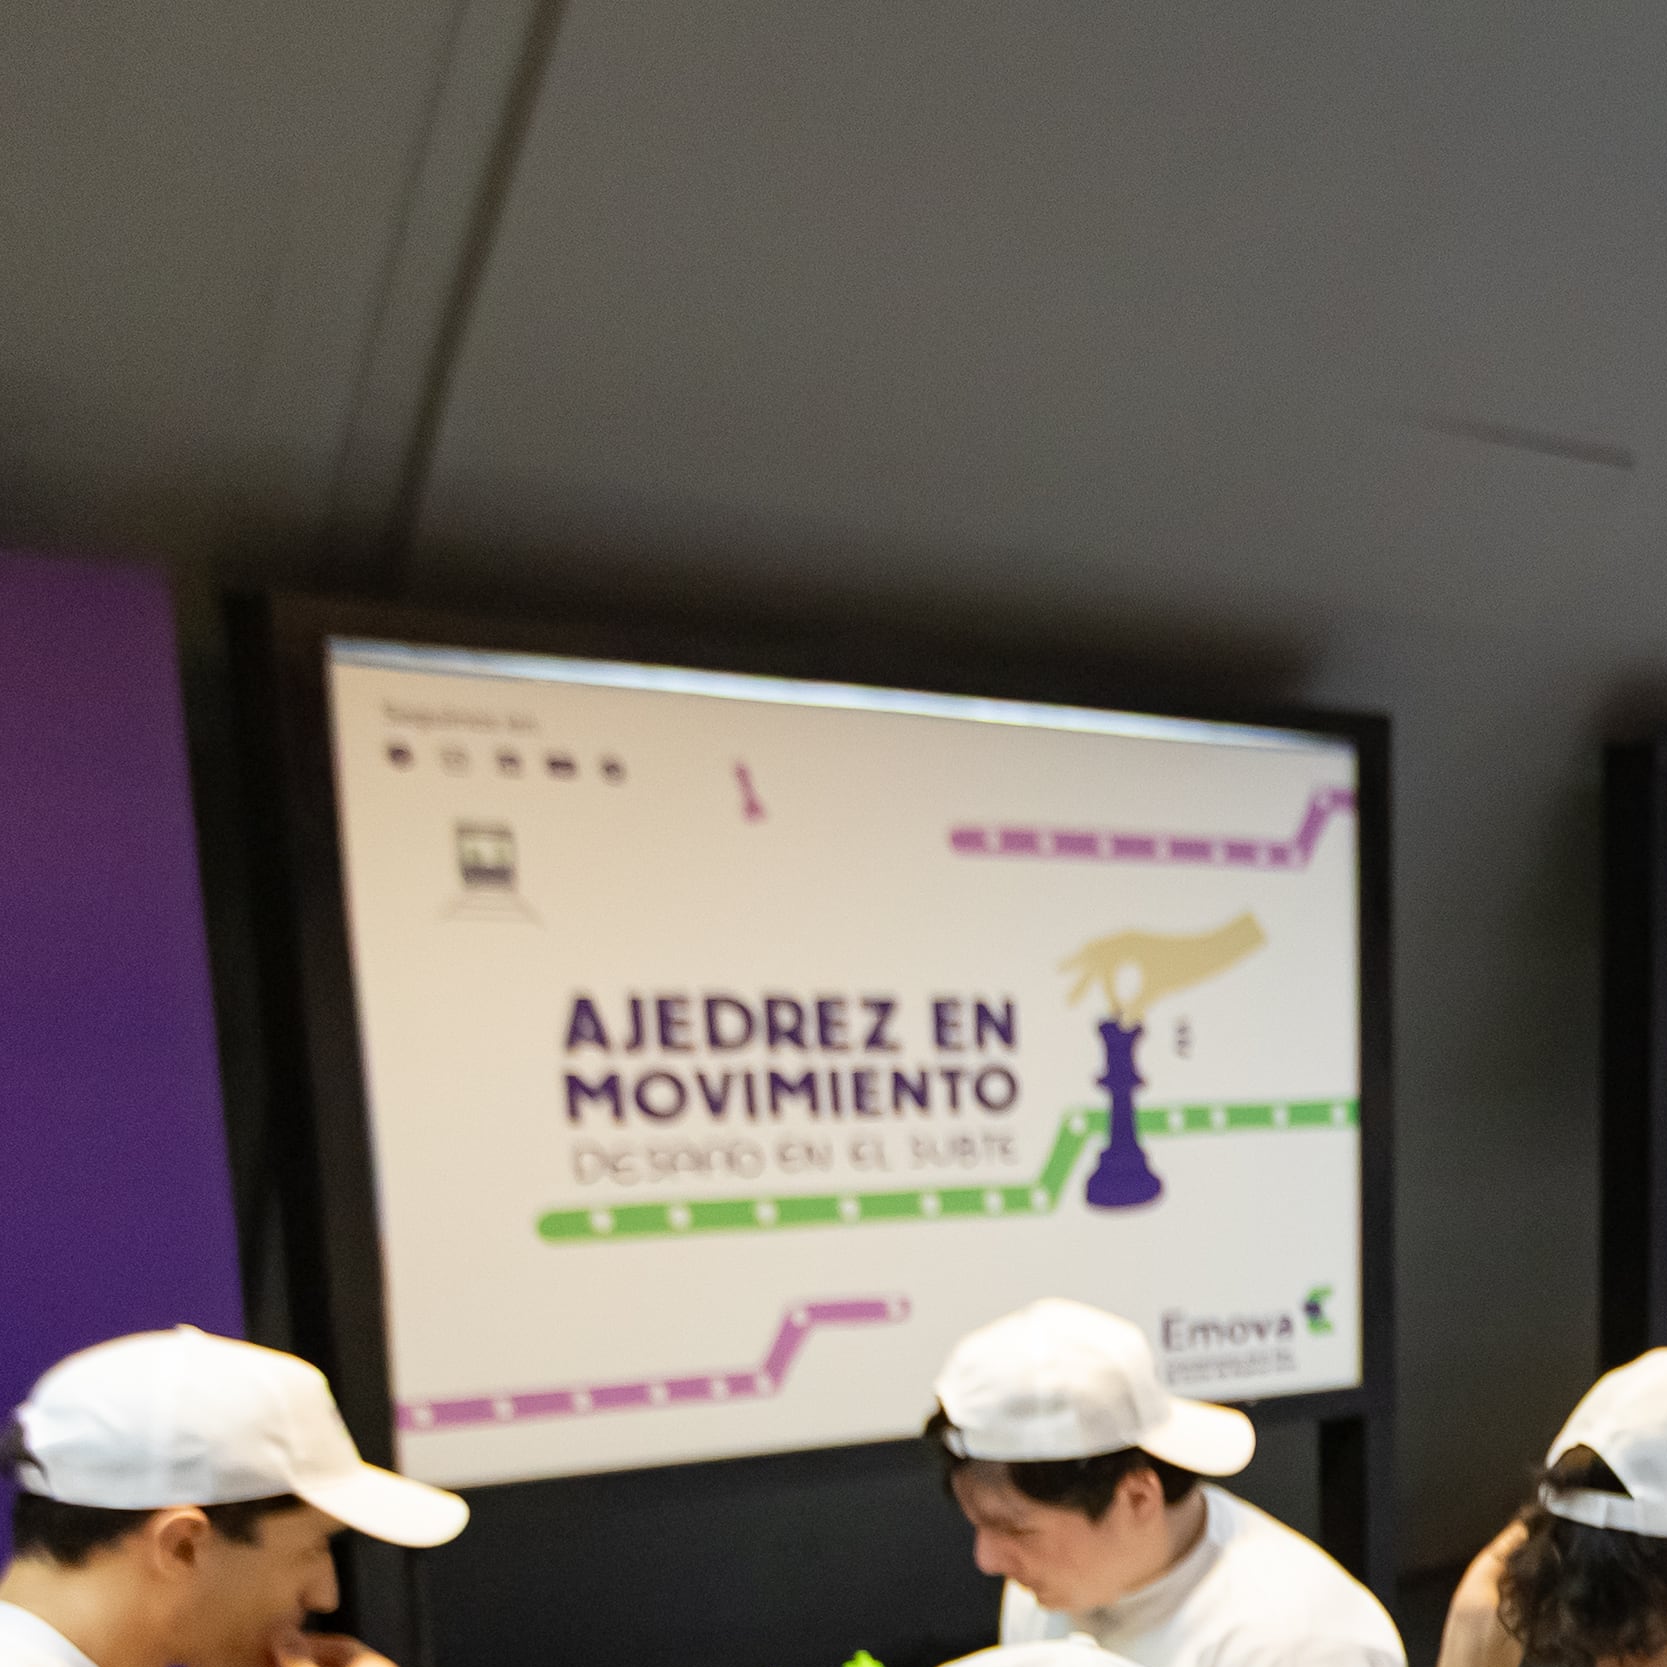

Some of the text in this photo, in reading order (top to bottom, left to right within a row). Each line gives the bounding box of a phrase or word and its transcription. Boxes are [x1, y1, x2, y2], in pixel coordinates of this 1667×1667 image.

[565, 993, 1020, 1053] AJEDREZ EN
[564, 1063, 1021, 1124] MOVIMIENTO
[774, 1136, 834, 1173] EN
[1161, 1306, 1295, 1350] Emova
